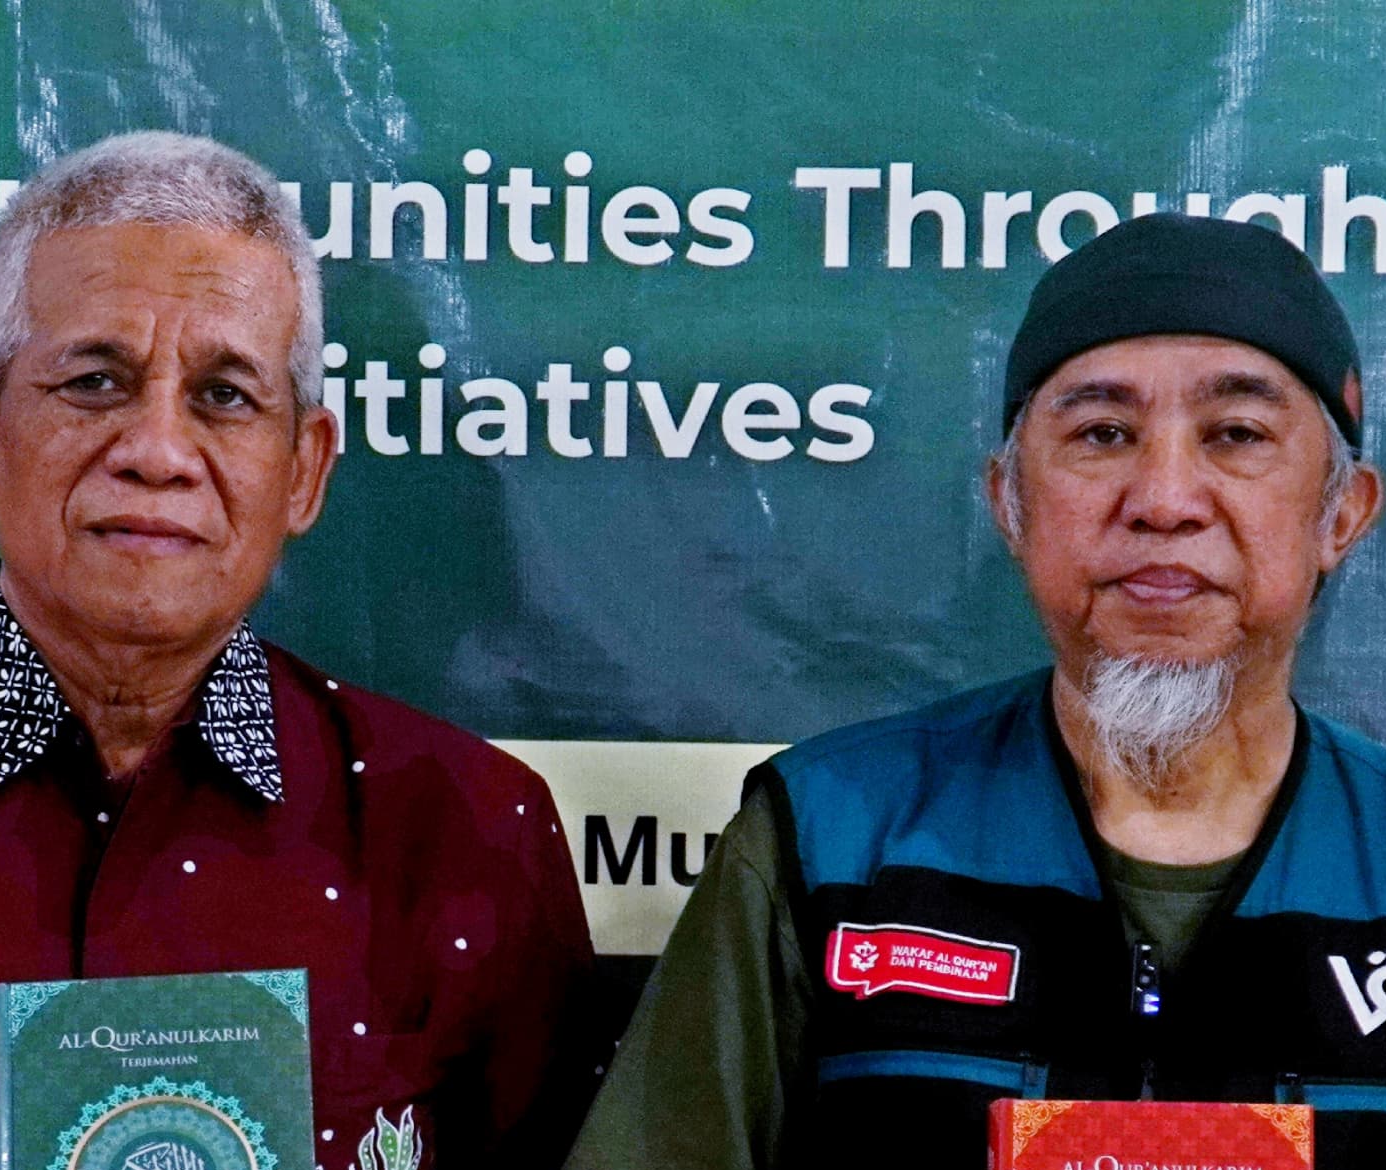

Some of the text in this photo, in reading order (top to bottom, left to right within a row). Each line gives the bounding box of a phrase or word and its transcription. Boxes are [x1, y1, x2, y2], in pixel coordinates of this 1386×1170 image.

[891, 945, 933, 960] WAKAF
[936, 953, 951, 964] AL
[890, 956, 990, 982] DAN PEMBINAAN
[121, 1054, 198, 1069] TERJEMAHAN
